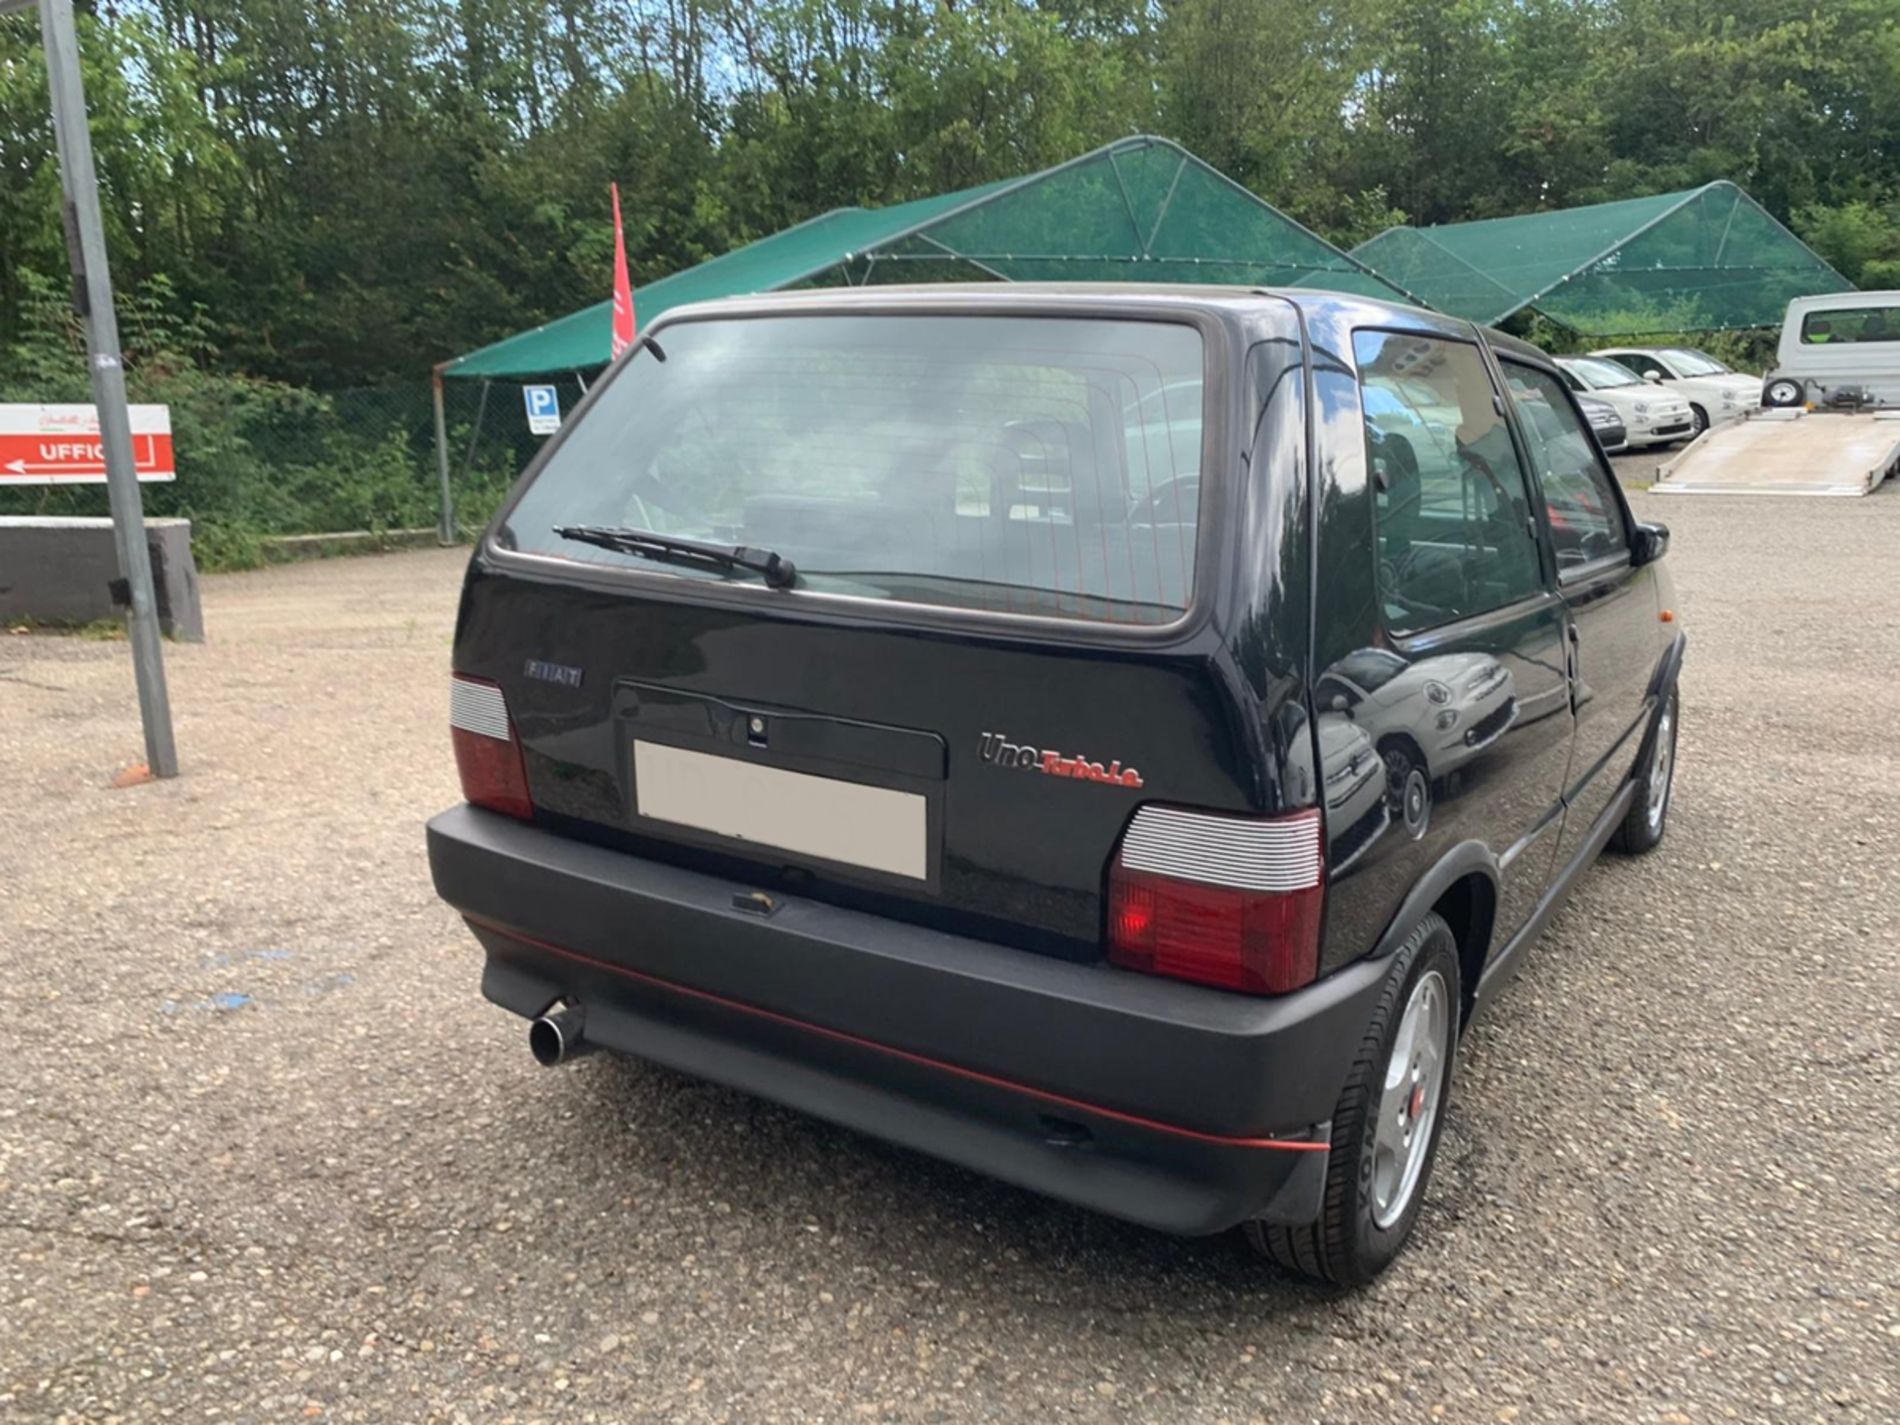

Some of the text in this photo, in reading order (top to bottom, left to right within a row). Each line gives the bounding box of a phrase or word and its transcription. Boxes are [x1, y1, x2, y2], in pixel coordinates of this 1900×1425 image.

[530, 390, 551, 415] P
[40, 443, 105, 460] UFFIC
[527, 660, 580, 686] FIAT
[978, 731, 1038, 770] Uno
